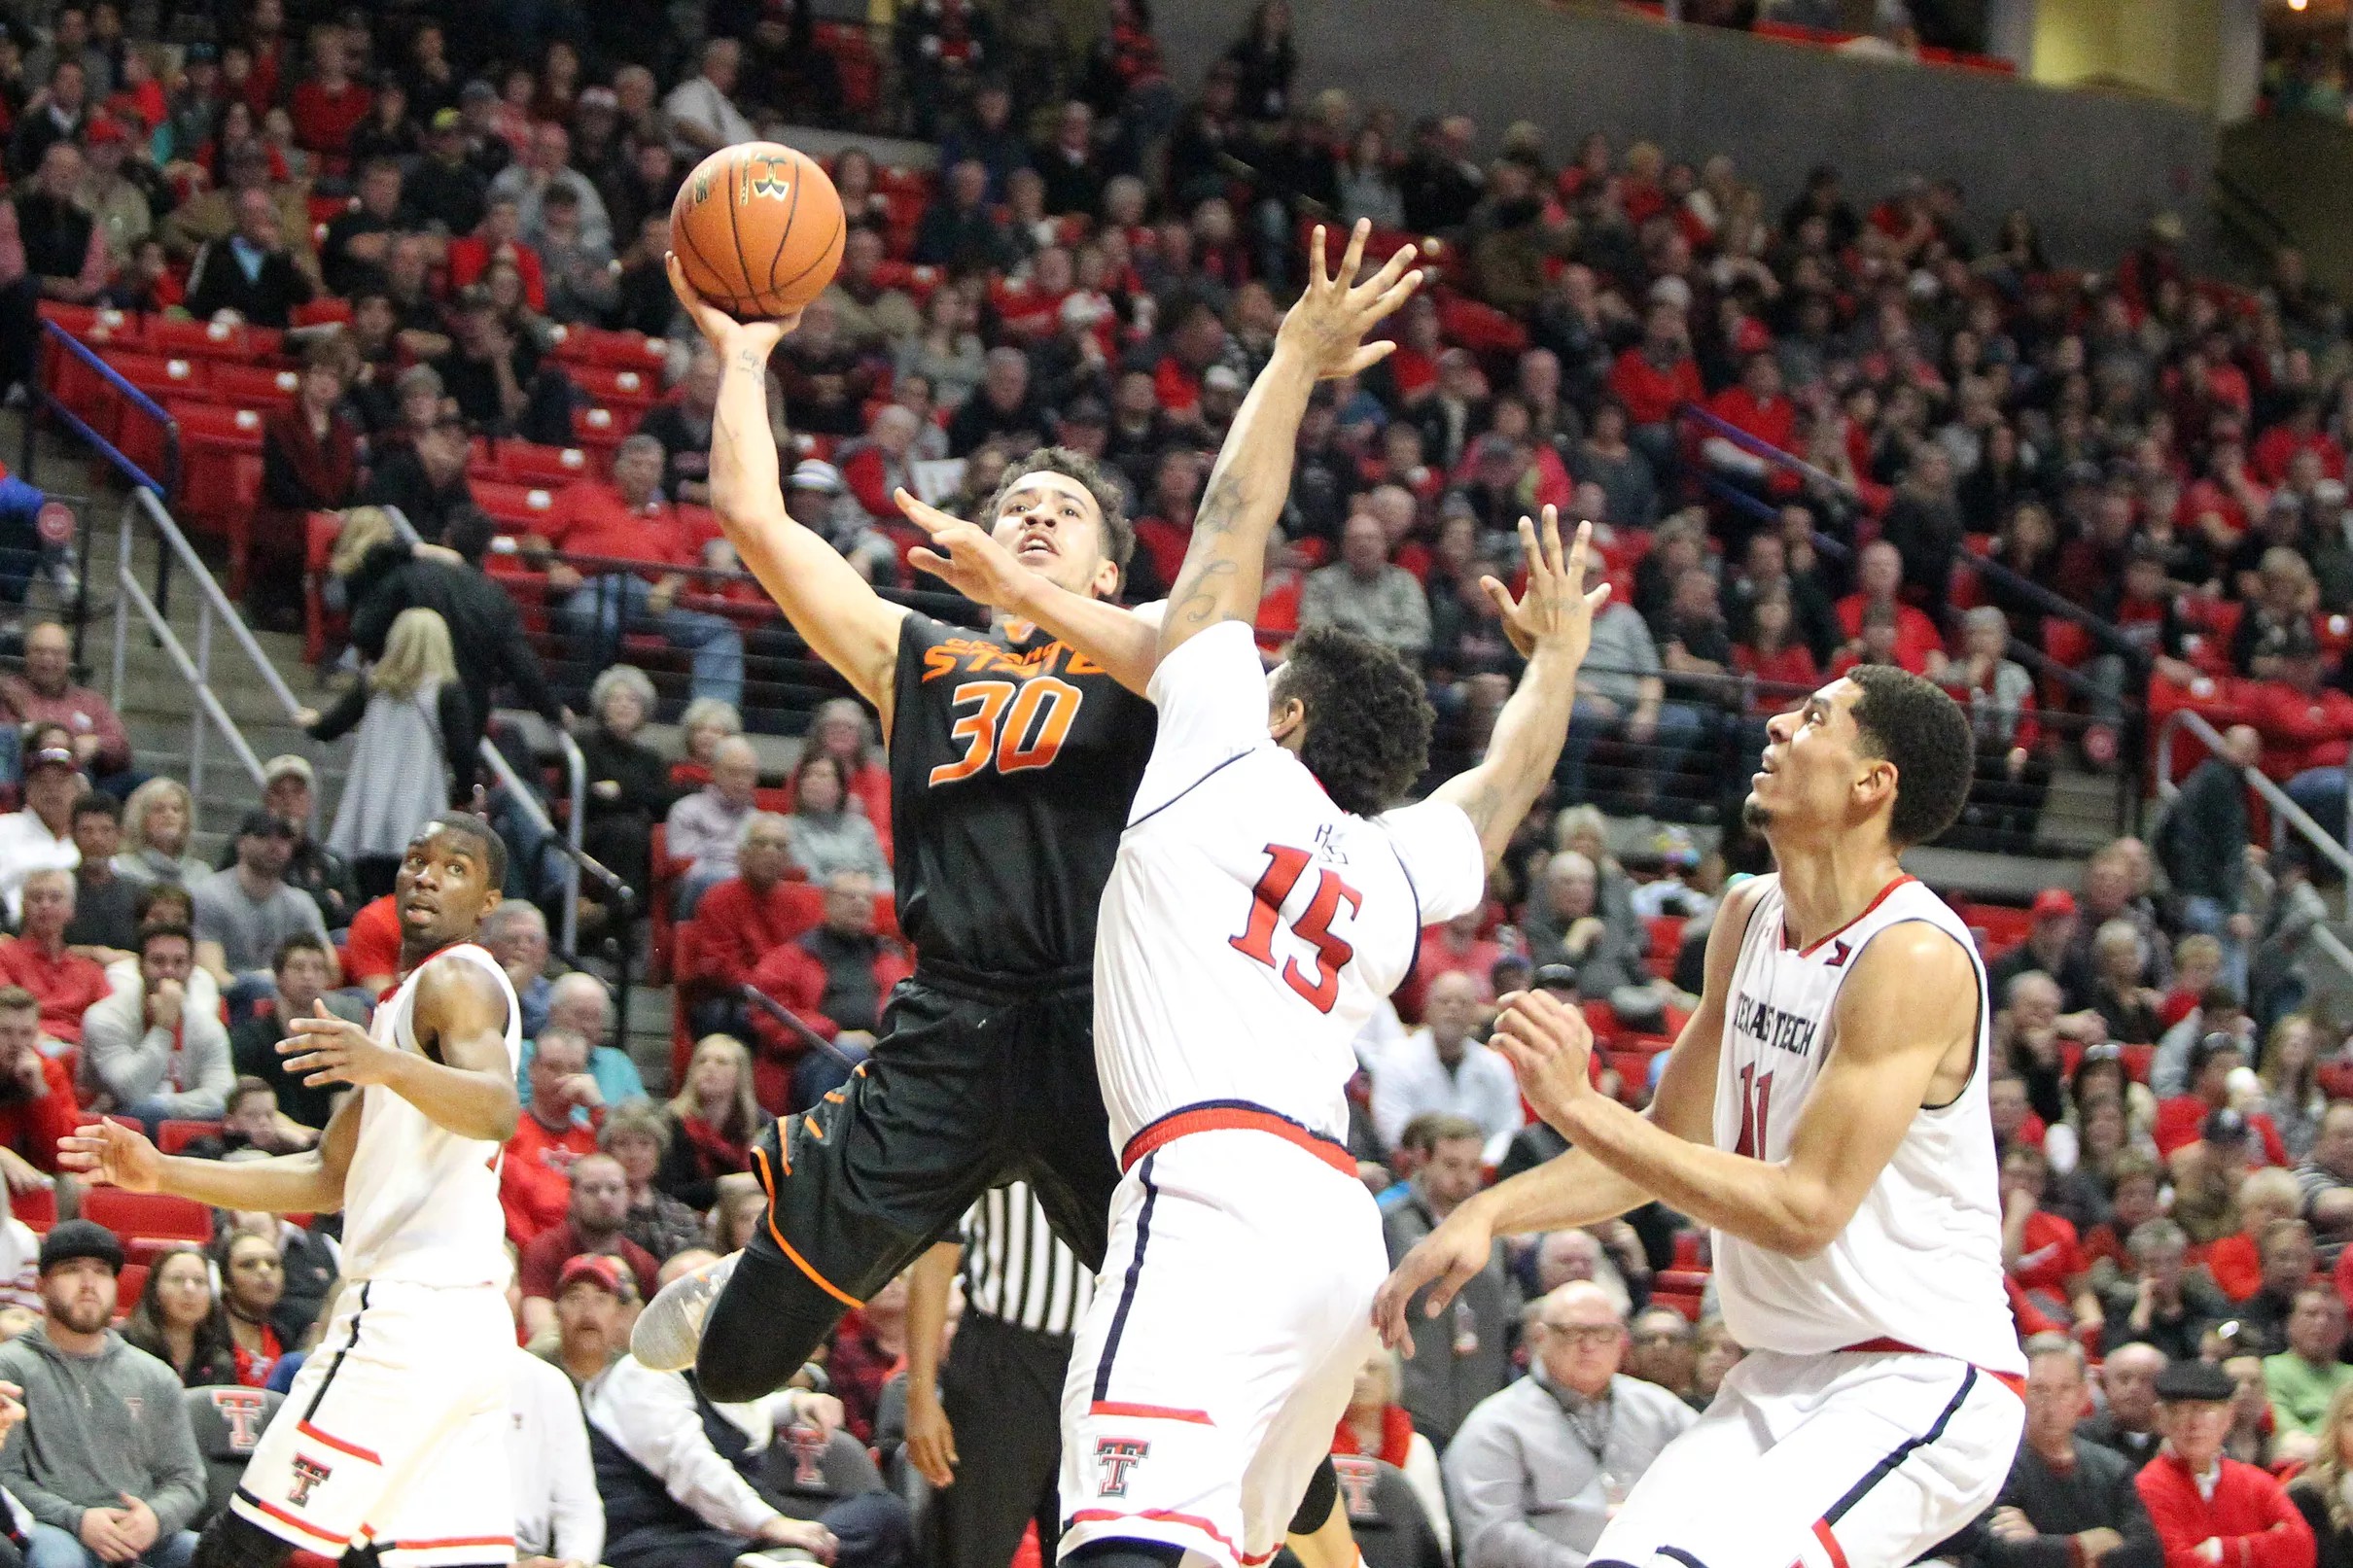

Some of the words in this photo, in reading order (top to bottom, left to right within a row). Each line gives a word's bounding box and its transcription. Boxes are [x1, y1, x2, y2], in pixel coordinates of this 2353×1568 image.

[929, 676, 1083, 787] 30
[1228, 842, 1363, 1014] 15
[1734, 992, 1775, 1041] TEXAS
[1772, 1010, 1817, 1057] TECH
[1735, 1061, 1774, 1162] 11
